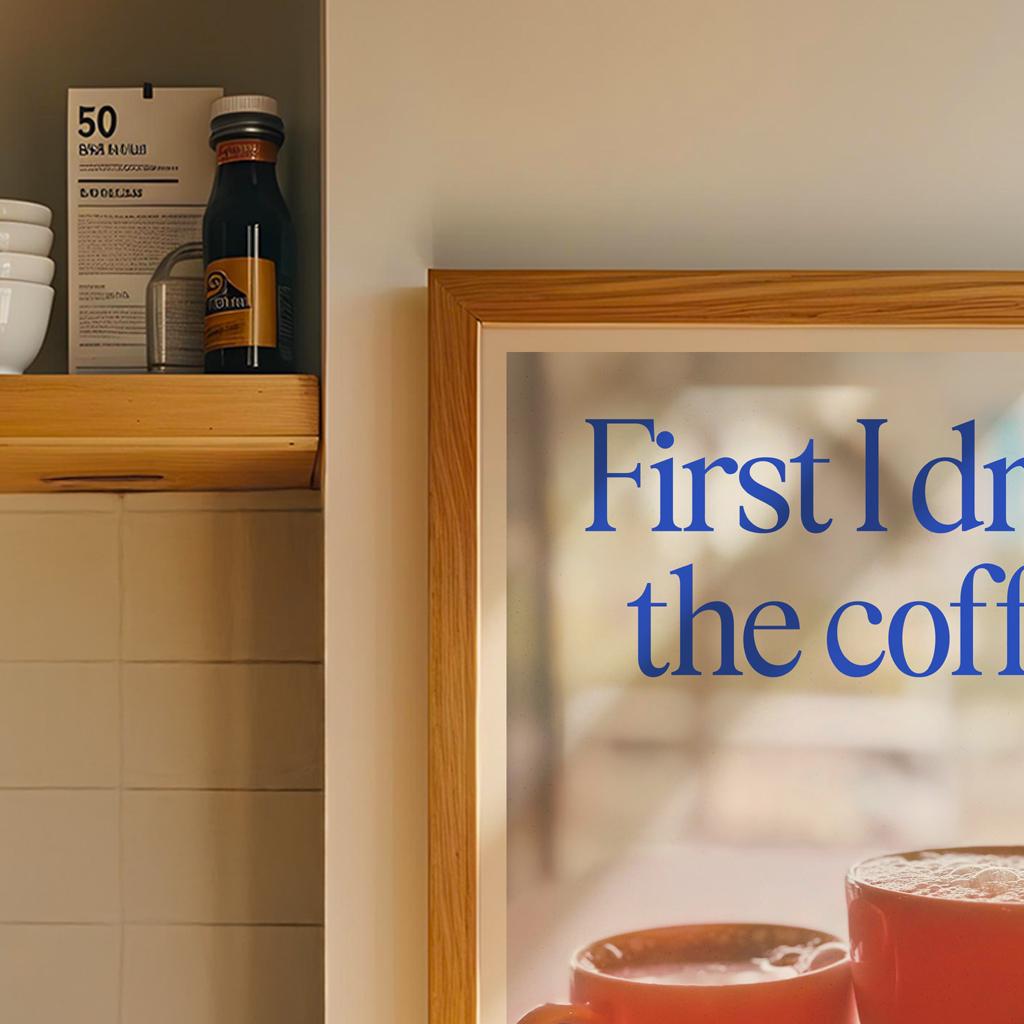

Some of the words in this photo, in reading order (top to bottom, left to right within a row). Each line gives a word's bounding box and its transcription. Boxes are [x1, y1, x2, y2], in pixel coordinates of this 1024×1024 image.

[78, 105, 117, 138] 50
[585, 418, 833, 533] First
[856, 418, 888, 533] I
[627, 563, 802, 678] the
